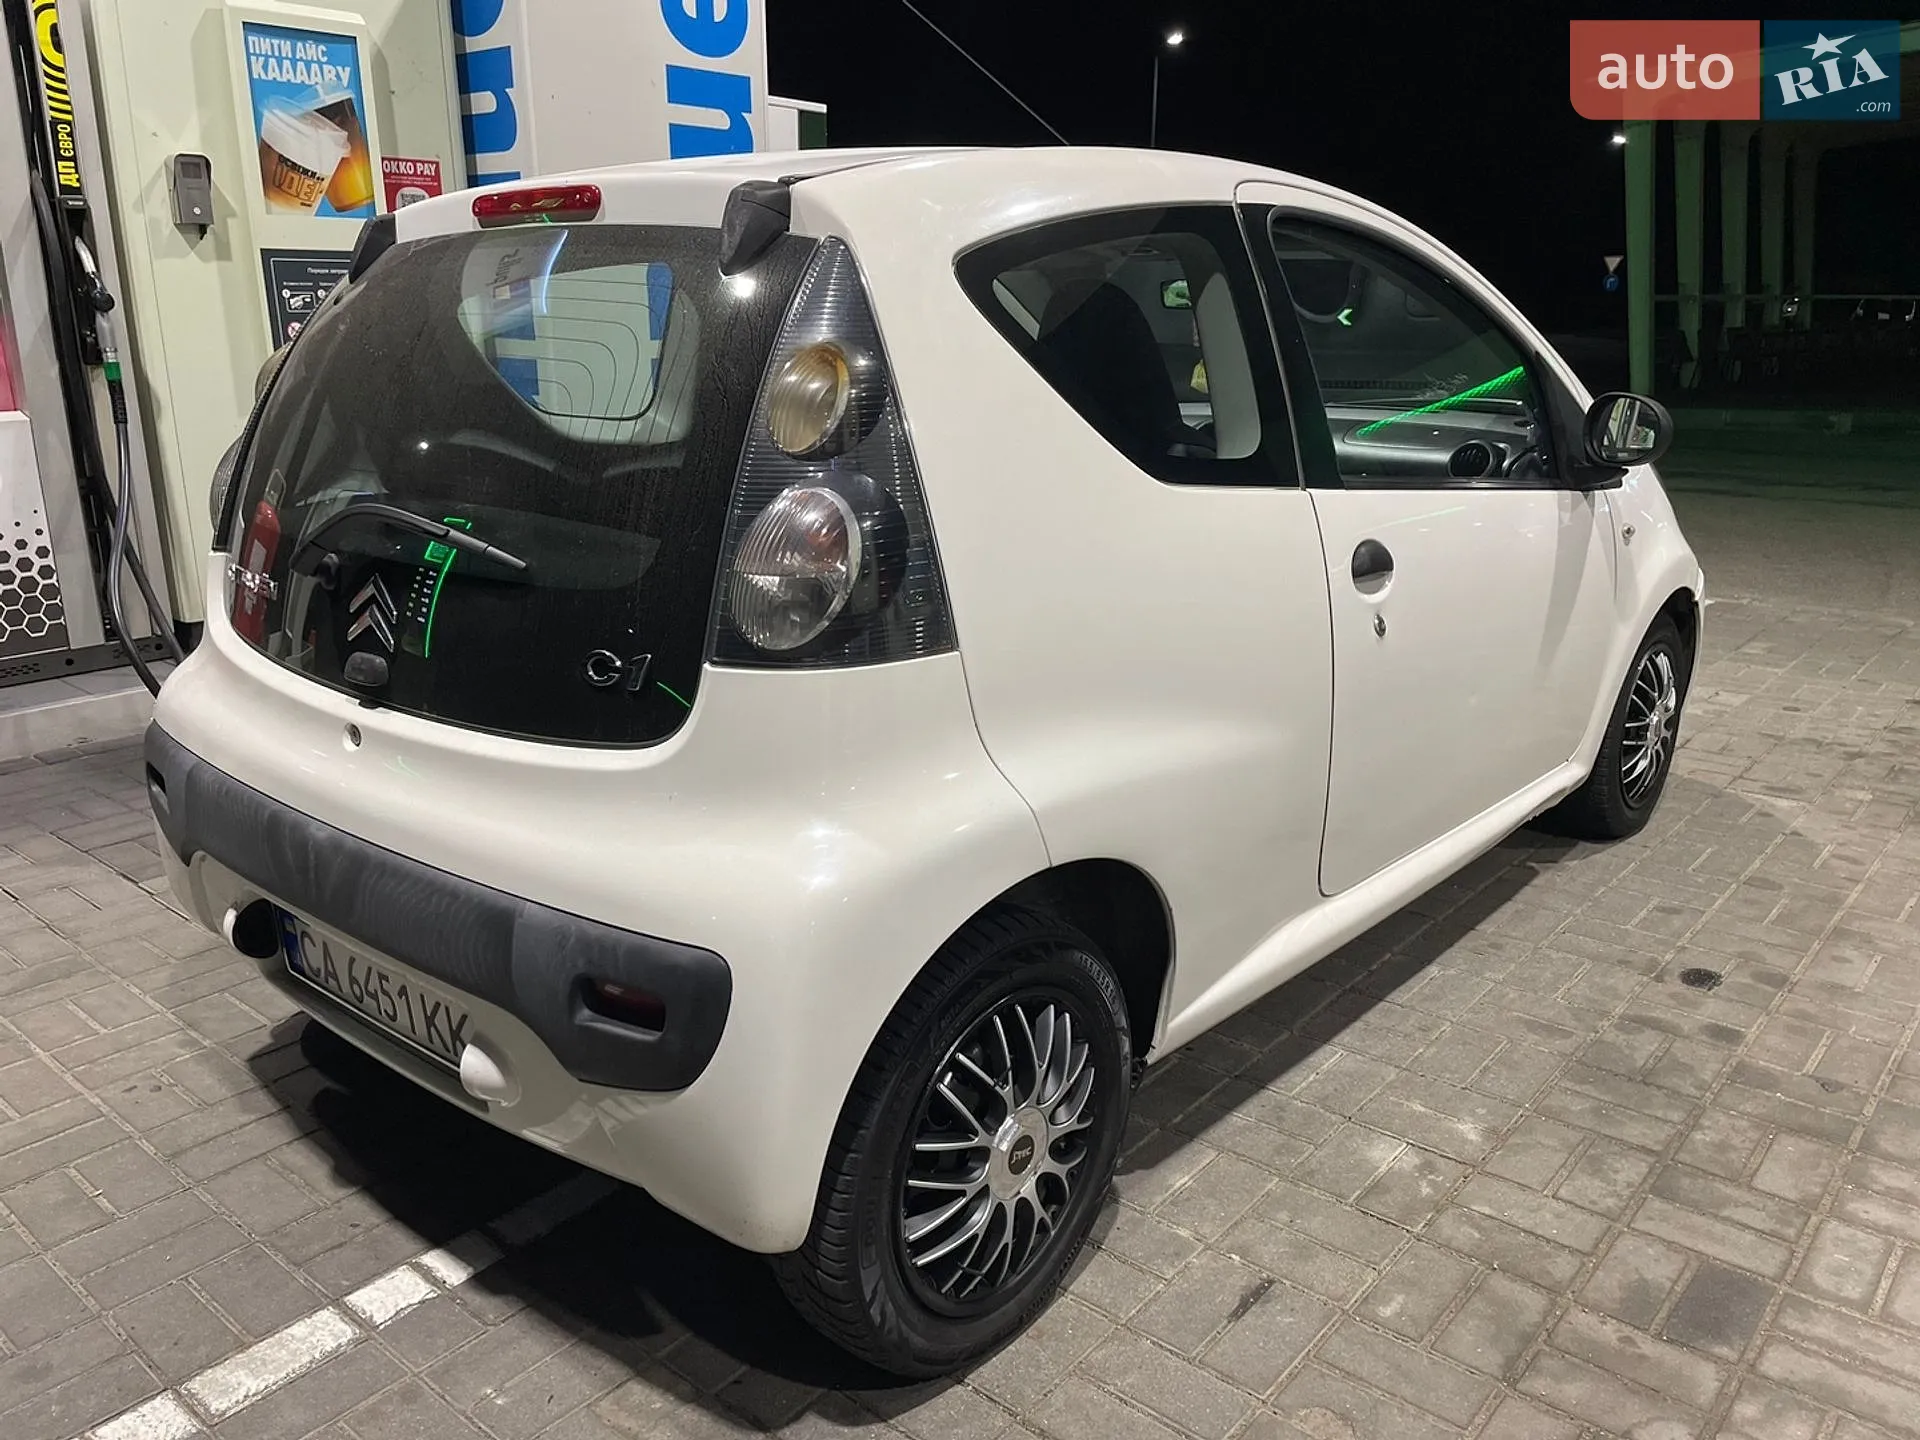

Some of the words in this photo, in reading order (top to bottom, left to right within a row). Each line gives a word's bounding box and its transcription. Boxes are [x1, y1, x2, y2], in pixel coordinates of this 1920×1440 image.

[248, 35, 292, 58] ПИТИ
[295, 40, 328, 62] АЙС
[57, 124, 74, 157] ЄВРО
[58, 160, 81, 188] ДП
[382, 160, 415, 175] OKKO
[416, 162, 436, 176] PAY
[582, 649, 652, 691] C1
[301, 930, 344, 995] CA
[349, 956, 417, 1036] 6451
